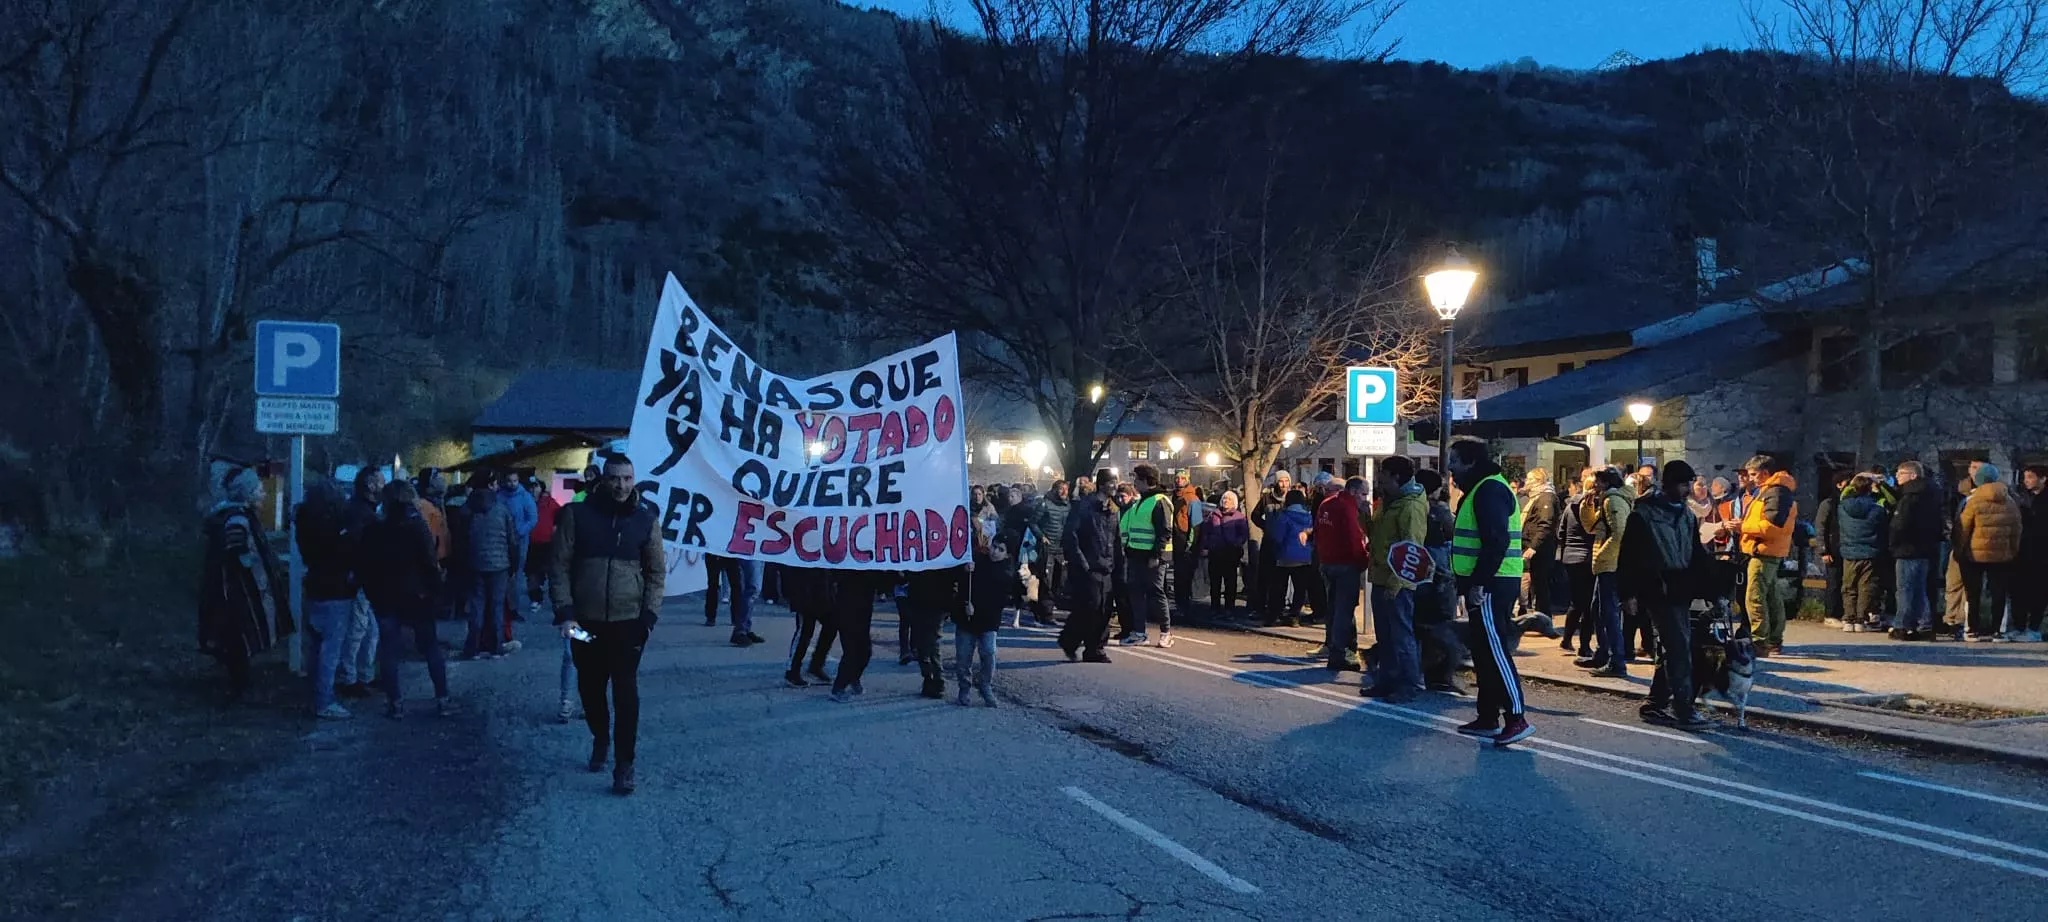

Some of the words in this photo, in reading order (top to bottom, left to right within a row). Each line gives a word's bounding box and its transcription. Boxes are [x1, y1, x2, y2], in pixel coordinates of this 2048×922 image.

[273, 331, 321, 386] P
[674, 306, 942, 410] BENASQUE
[644, 348, 703, 426] YA
[720, 393, 783, 460] HA
[794, 394, 956, 468] VOTADO
[1357, 375, 1386, 418] P
[650, 416, 702, 477] Y
[635, 480, 714, 547] SER
[726, 500, 969, 564] ESCUCHADO
[1400, 545, 1422, 580] STOP
